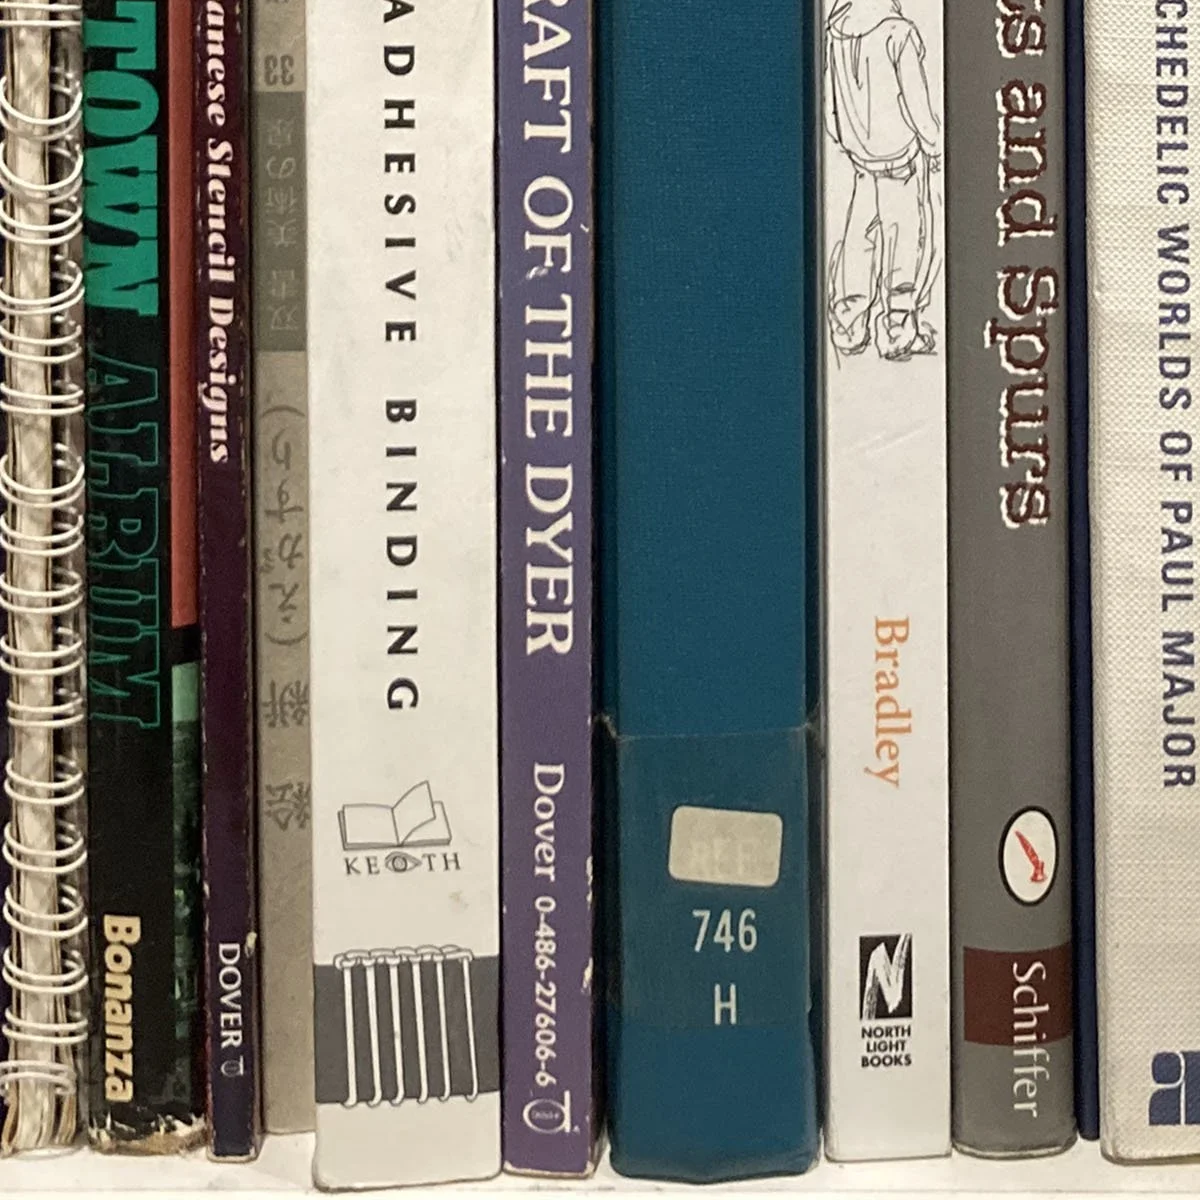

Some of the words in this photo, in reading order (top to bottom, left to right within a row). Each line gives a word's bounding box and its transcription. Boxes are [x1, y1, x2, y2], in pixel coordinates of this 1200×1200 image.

[263, 54, 296, 88] 33
[82, 0, 160, 317] TOWN
[206, 136, 236, 283] Stencil
[522, 175, 574, 275] OF
[995, 78, 1059, 247] and
[197, 294, 237, 465] Designs
[523, 293, 574, 440] THE
[1156, 222, 1192, 411] WORLDS
[983, 264, 1061, 530] Spurs
[1158, 430, 1194, 484] OF
[86, 349, 161, 729] ALBUM
[384, 398, 420, 711] BINDING
[524, 462, 575, 657] DYER
[1160, 500, 1195, 614] PAUL
[863, 614, 914, 789] Bradley
[1161, 630, 1198, 788] MAJOR
[532, 761, 566, 882] Dover
[218, 942, 243, 1049] DOVER
[532, 895, 558, 1089] 0-486-27606-6
[691, 909, 759, 953] 746
[713, 983, 738, 1026] H
[102, 913, 142, 1103] Bonanza
[860, 1024, 913, 1040] NORTH
[860, 1054, 913, 1069] BOOKS
[864, 1039, 908, 1055] LIGHT
[1012, 960, 1051, 1119] Schiffer
